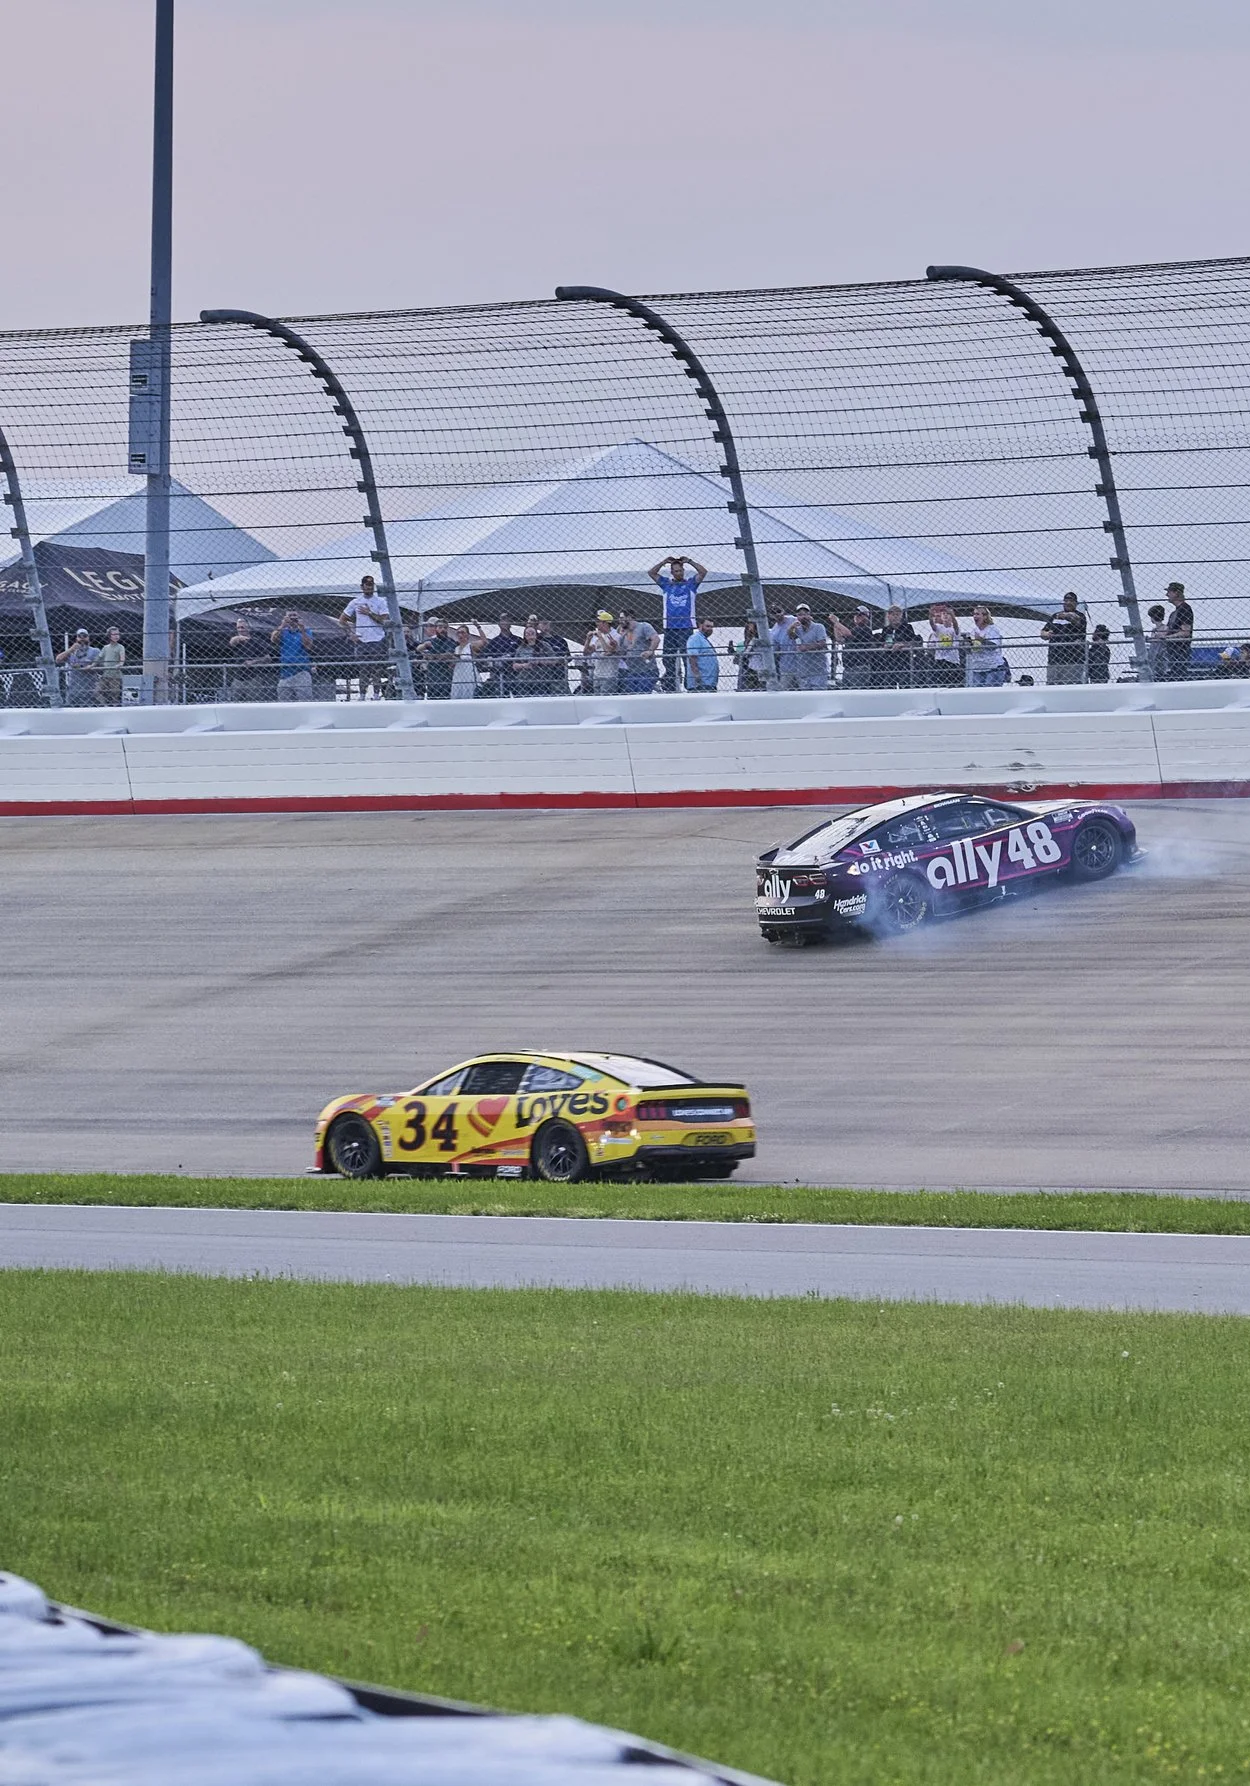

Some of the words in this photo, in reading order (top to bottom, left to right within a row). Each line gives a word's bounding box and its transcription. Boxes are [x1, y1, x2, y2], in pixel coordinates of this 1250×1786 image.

[871, 856, 884, 871] it
[883, 849, 918, 870] right.
[926, 837, 1002, 889] ally
[1008, 822, 1062, 870] 48
[764, 874, 791, 904] ally
[815, 889, 826, 900] 48
[398, 1100, 459, 1152] 34
